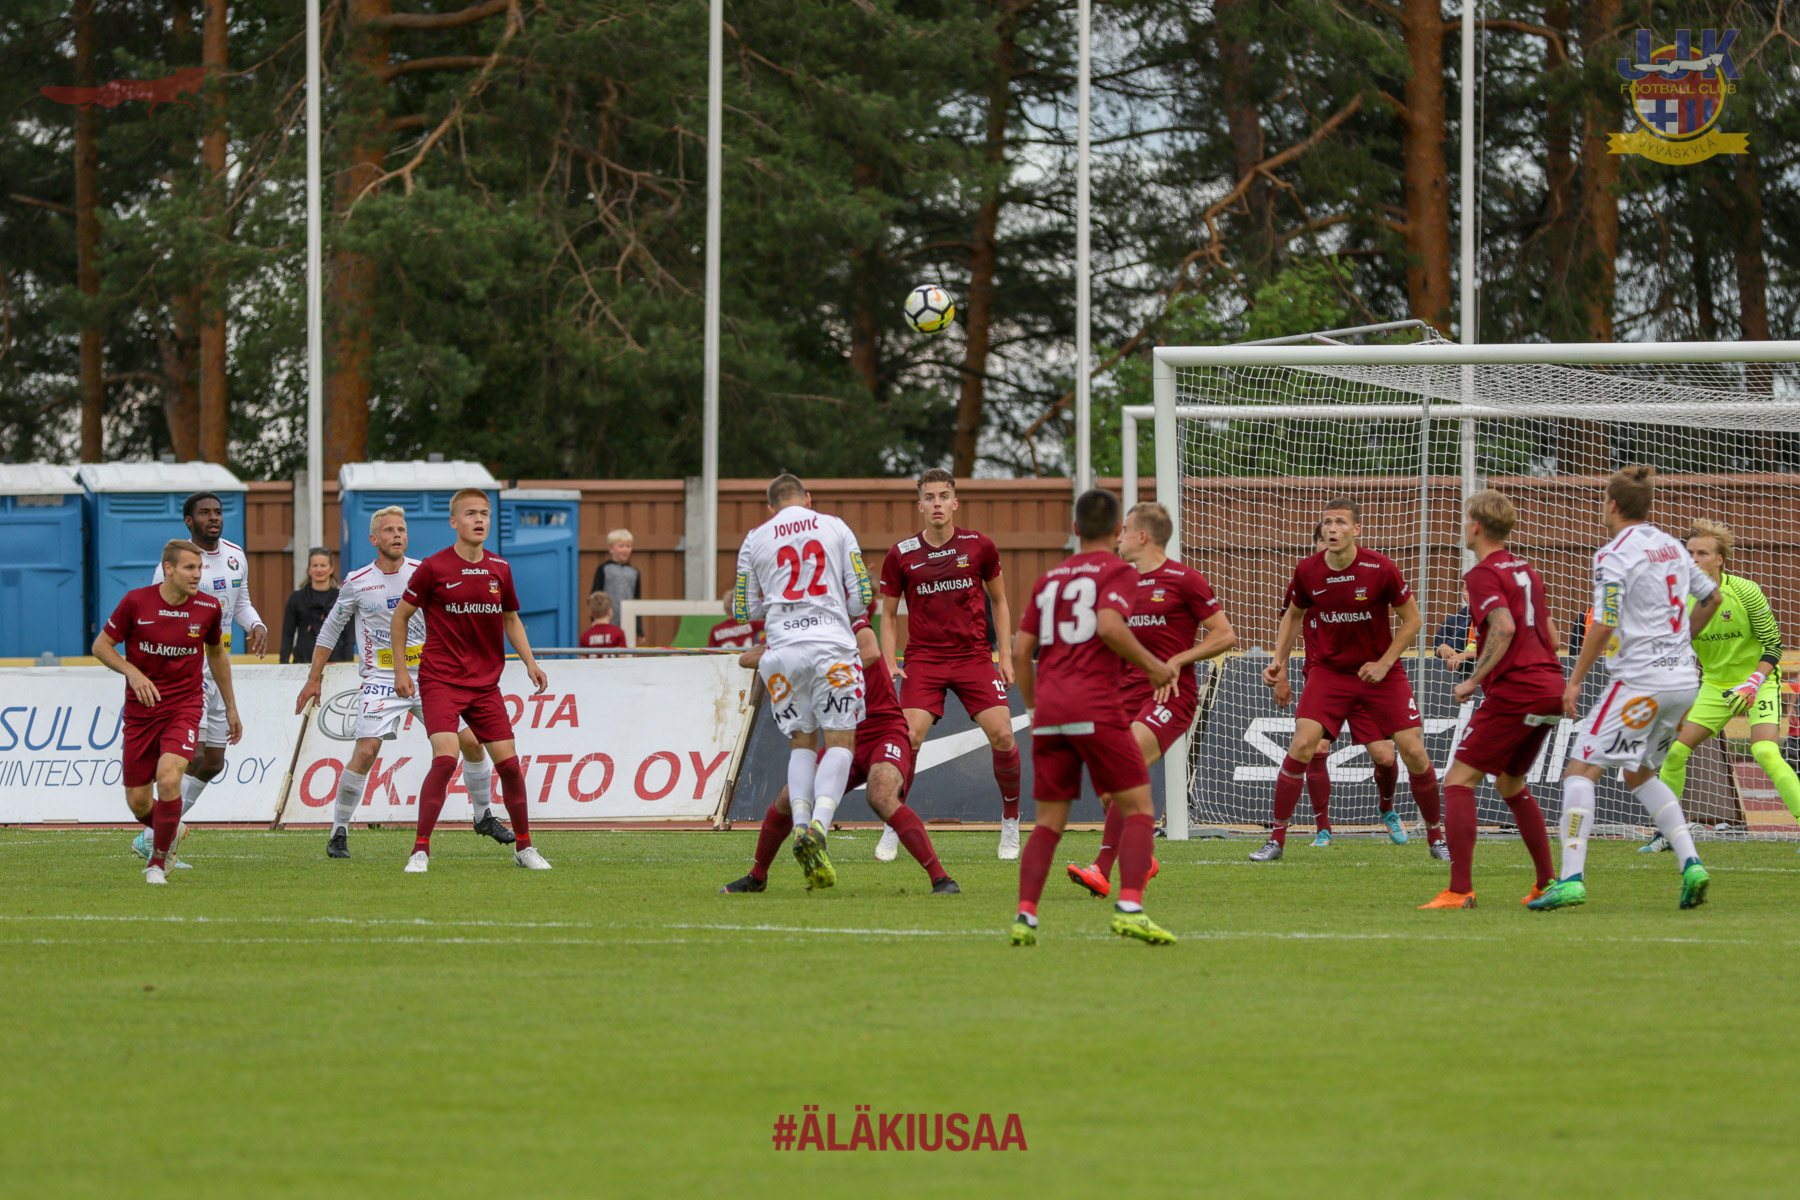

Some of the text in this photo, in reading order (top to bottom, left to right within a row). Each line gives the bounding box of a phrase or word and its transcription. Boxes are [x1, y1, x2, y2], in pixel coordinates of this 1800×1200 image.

[774, 515, 818, 539] JOVOVIĆ
[928, 548, 957, 559] stadium
[777, 539, 828, 600] 22
[916, 577, 974, 596] #ÄLÄKIUSAA
[1326, 575, 1355, 584] stadium
[1512, 570, 1535, 626] 7
[1666, 574, 1684, 634] 5
[158, 609, 189, 618] stadium
[1036, 576, 1098, 646] 13
[1127, 615, 1167, 627] KIUSAA
[363, 701, 370, 713] 7
[1408, 697, 1416, 711] 4
[1758, 700, 1774, 712] 31
[1153, 704, 1173, 724] 16
[0, 706, 125, 752] SULU
[187, 729, 196, 743] 5
[884, 742, 902, 758] 18
[237, 756, 277, 784] OY
[635, 750, 730, 801] OY
